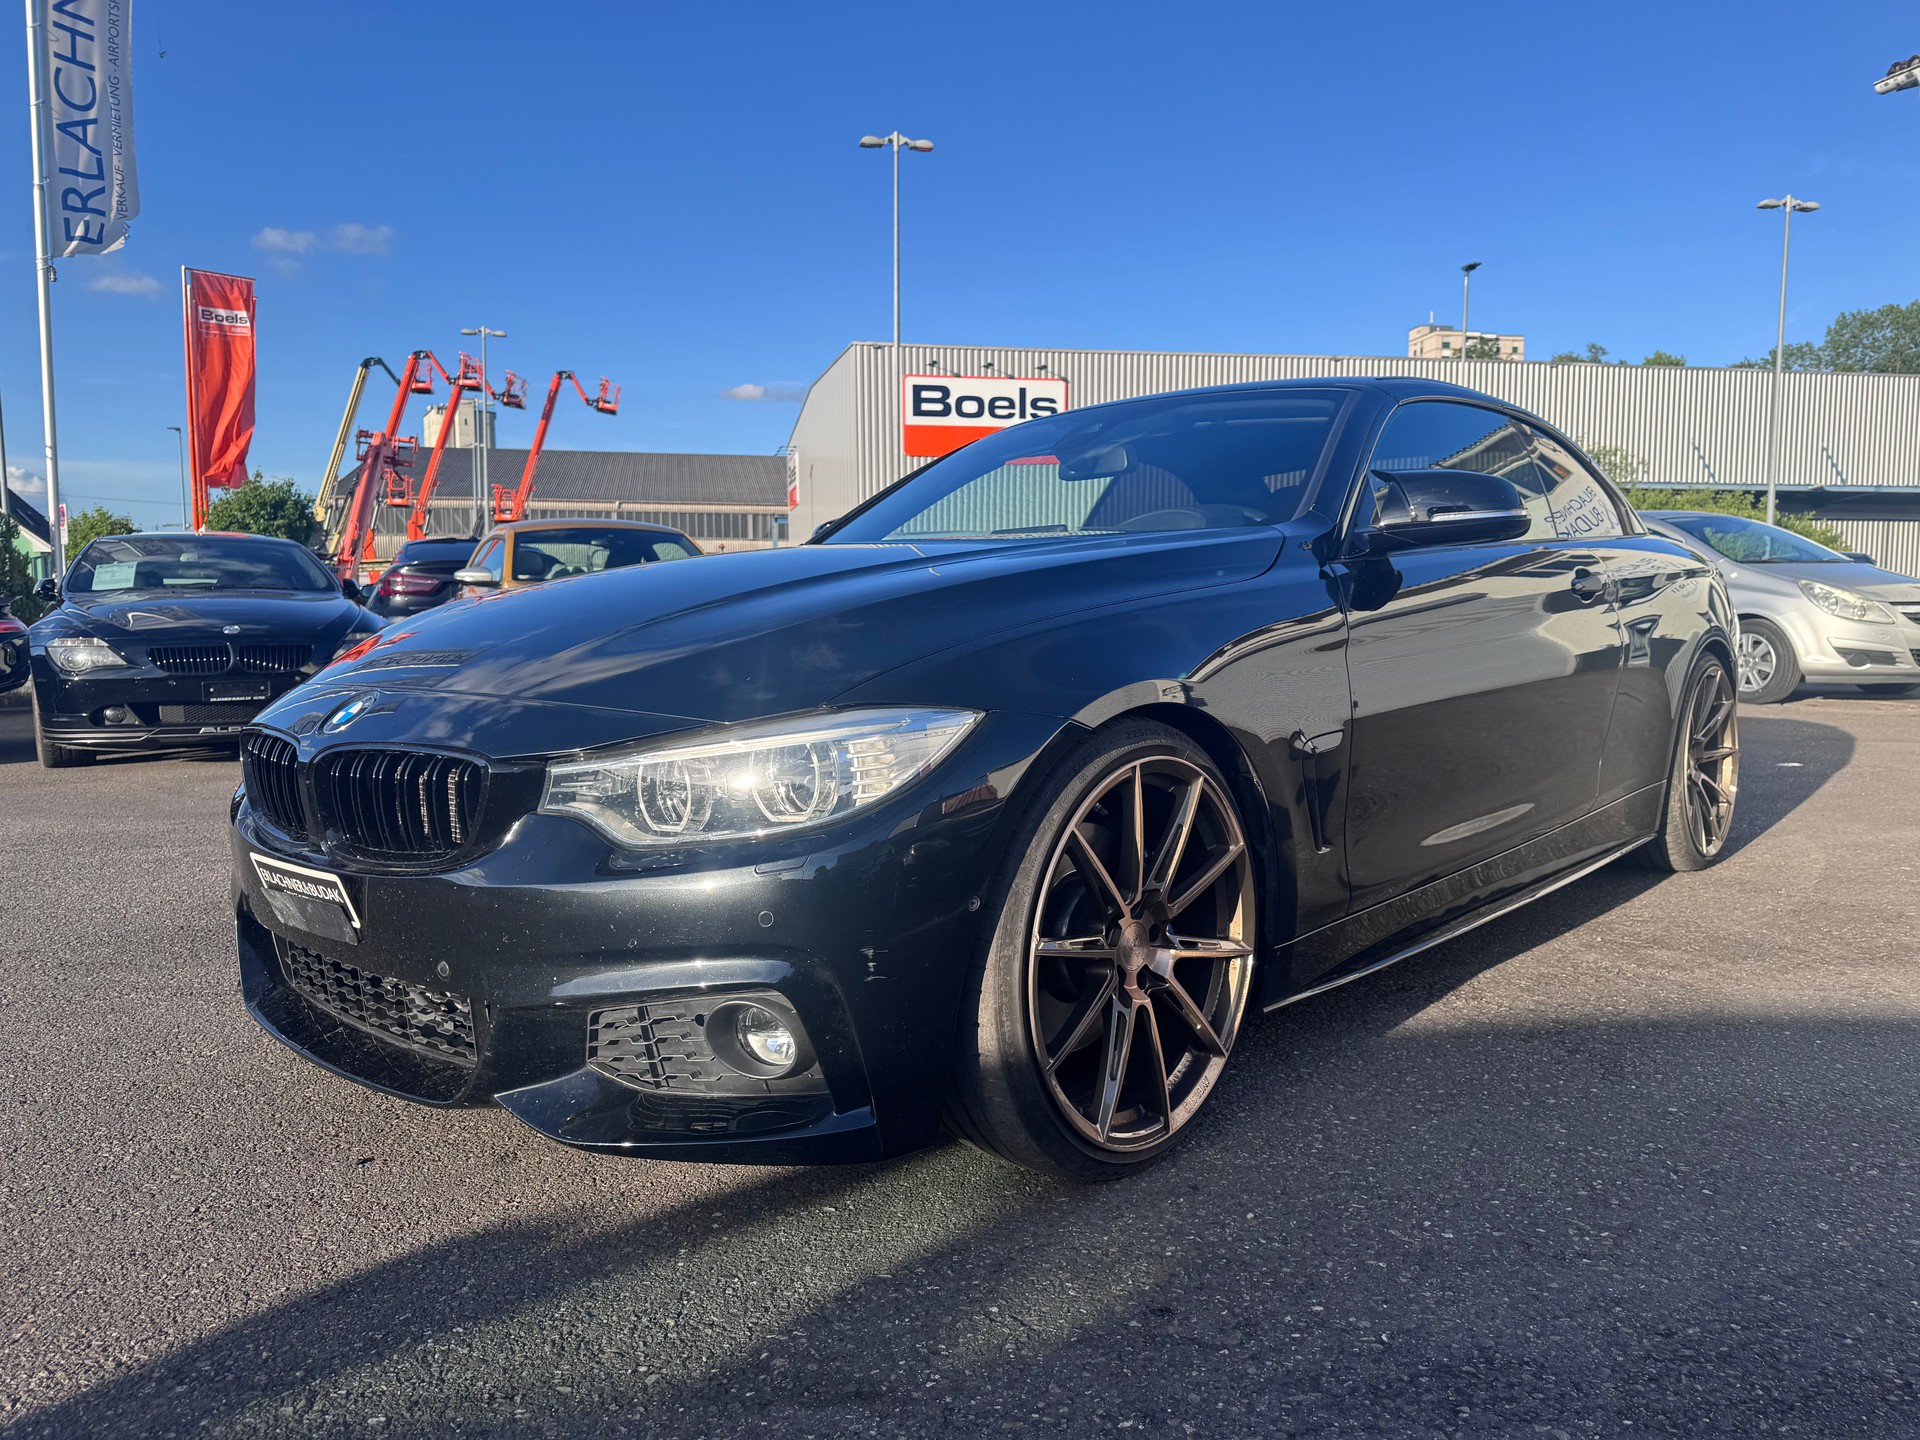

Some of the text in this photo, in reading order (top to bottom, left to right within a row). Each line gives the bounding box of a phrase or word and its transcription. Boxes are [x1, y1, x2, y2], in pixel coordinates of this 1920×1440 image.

[108, 75, 123, 156] VERMIETUNG
[112, 165, 129, 220] VERKAUF
[201, 309, 248, 325] Boels
[912, 384, 1058, 419] Boels
